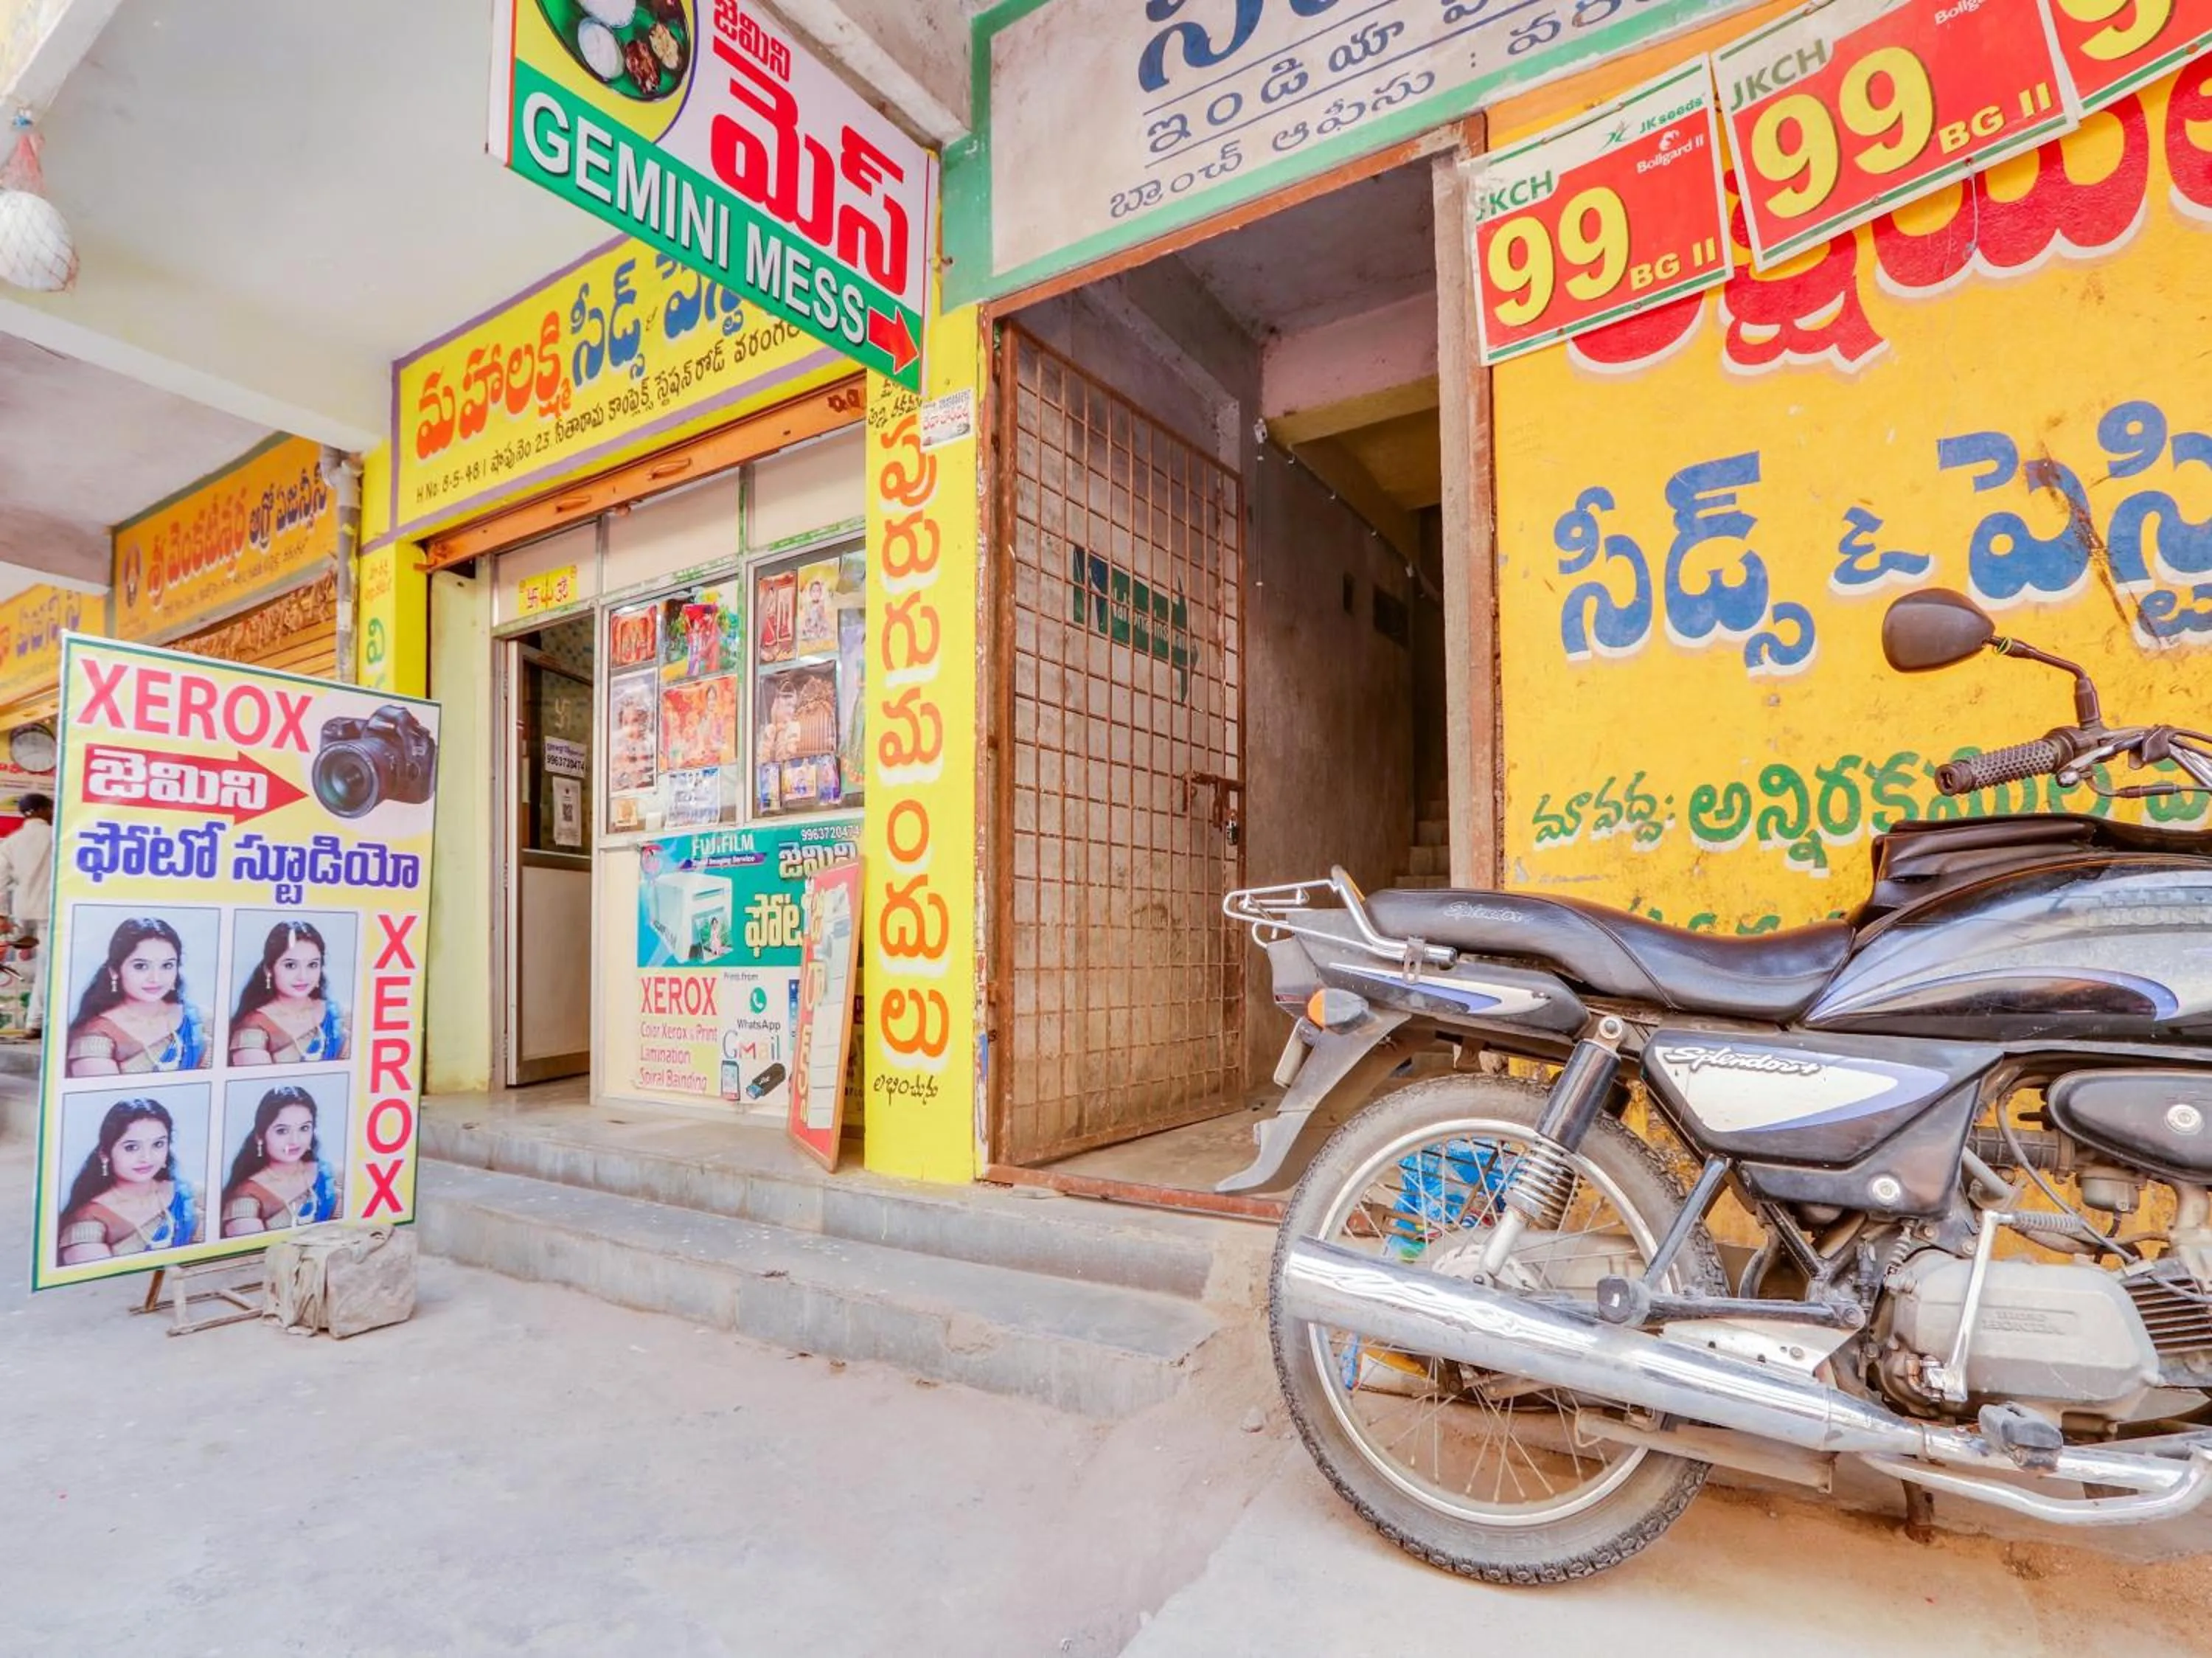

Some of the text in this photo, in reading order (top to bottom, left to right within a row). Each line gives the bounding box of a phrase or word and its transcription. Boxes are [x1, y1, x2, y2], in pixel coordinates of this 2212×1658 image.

[1147, 21, 1405, 153] ఇండియా
[1731, 40, 1826, 112] JKCH
[1751, 46, 1935, 218] 99
[1938, 83, 2052, 154] BG II
[710, 35, 908, 296] మెస్
[1636, 137, 1693, 174] Bollgard
[522, 92, 866, 344] GEMINI MESS
[1488, 187, 1629, 327] 99
[1630, 237, 1717, 291] BG II
[77, 659, 313, 753] XEROX
[88, 749, 268, 810] జెమిని
[76, 821, 420, 904] ఫోటో స్టూడియో
[639, 976, 718, 1016] XEROX
[661, 1022, 688, 1039] Xerox
[737, 1019, 782, 1031] WhatsApp
[361, 914, 419, 1219] XEROX
[639, 1067, 665, 1087] Spiral
[640, 1044, 692, 1064] Lamination
[722, 1029, 781, 1061] Gmail
